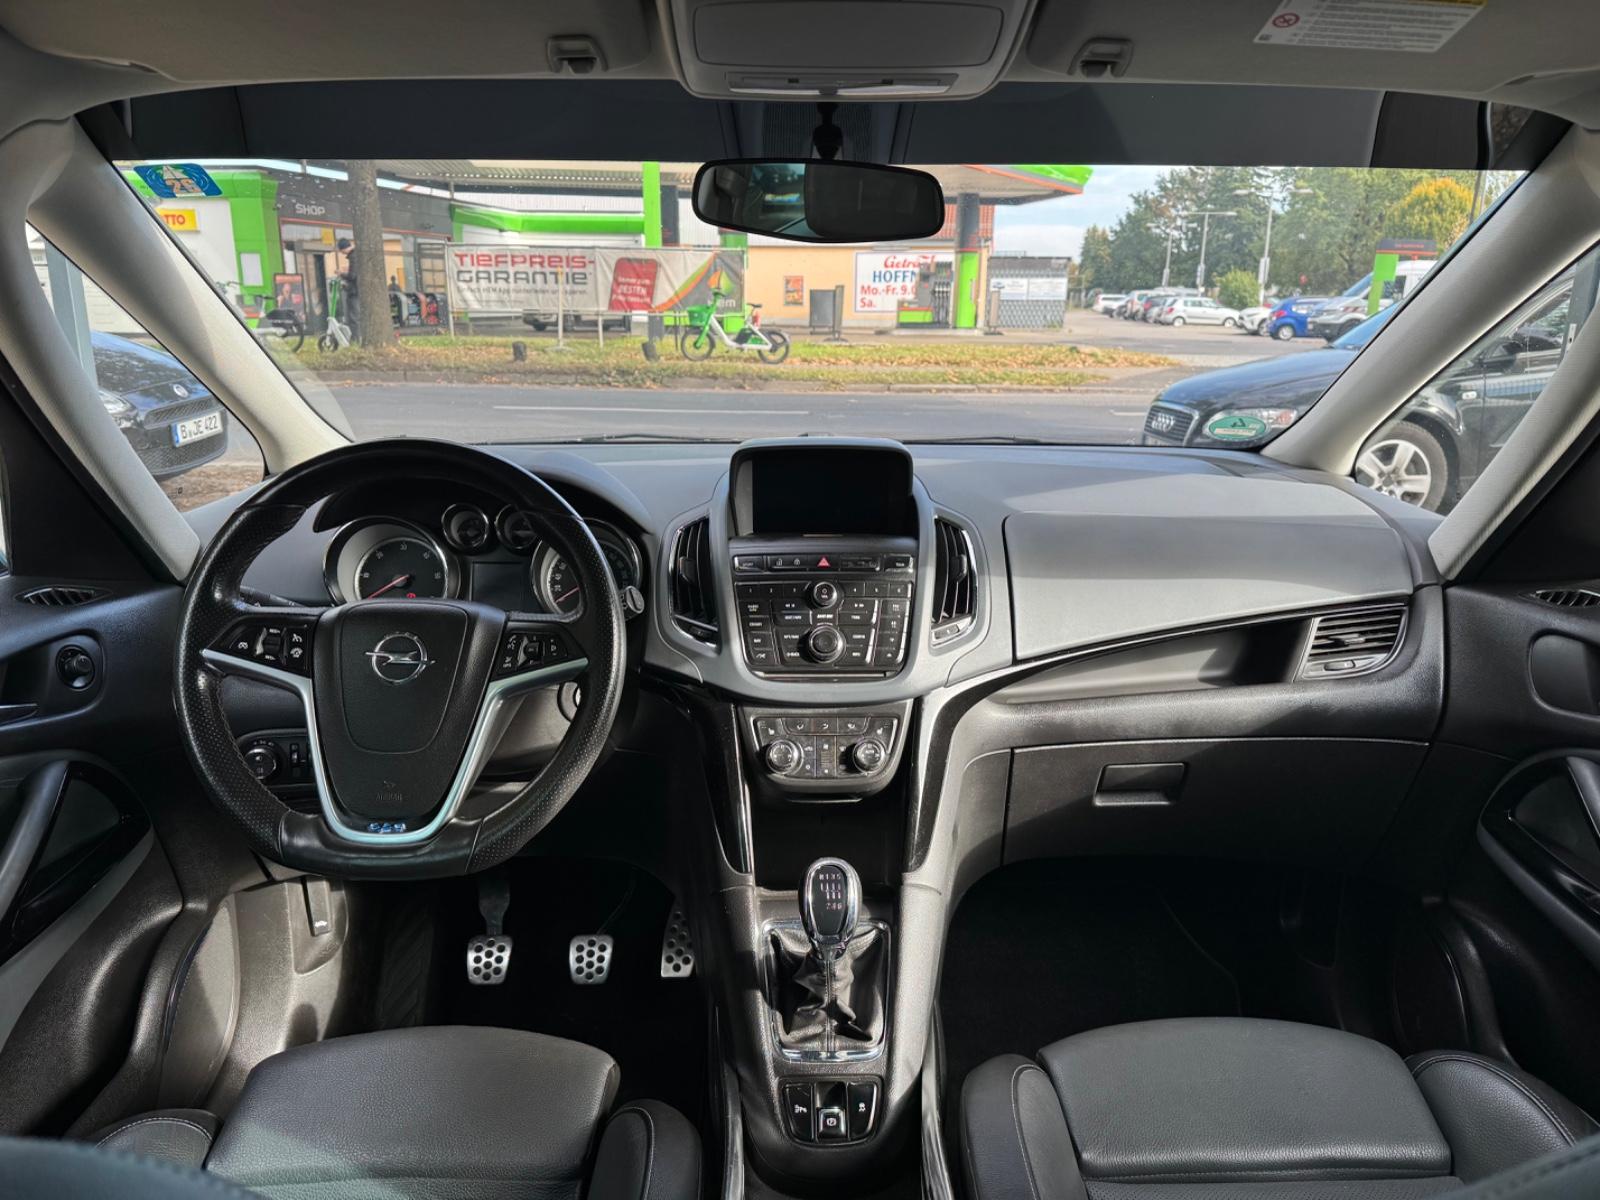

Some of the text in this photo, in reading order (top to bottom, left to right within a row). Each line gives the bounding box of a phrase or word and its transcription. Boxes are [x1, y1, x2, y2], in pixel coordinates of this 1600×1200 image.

[295, 203, 326, 216] SHOP
[454, 252, 595, 269] TIEFPREIS-
[456, 270, 588, 285] GARANTIE
[861, 284, 898, 296] Mo.-Fr.
[860, 298, 877, 308] Sa.
